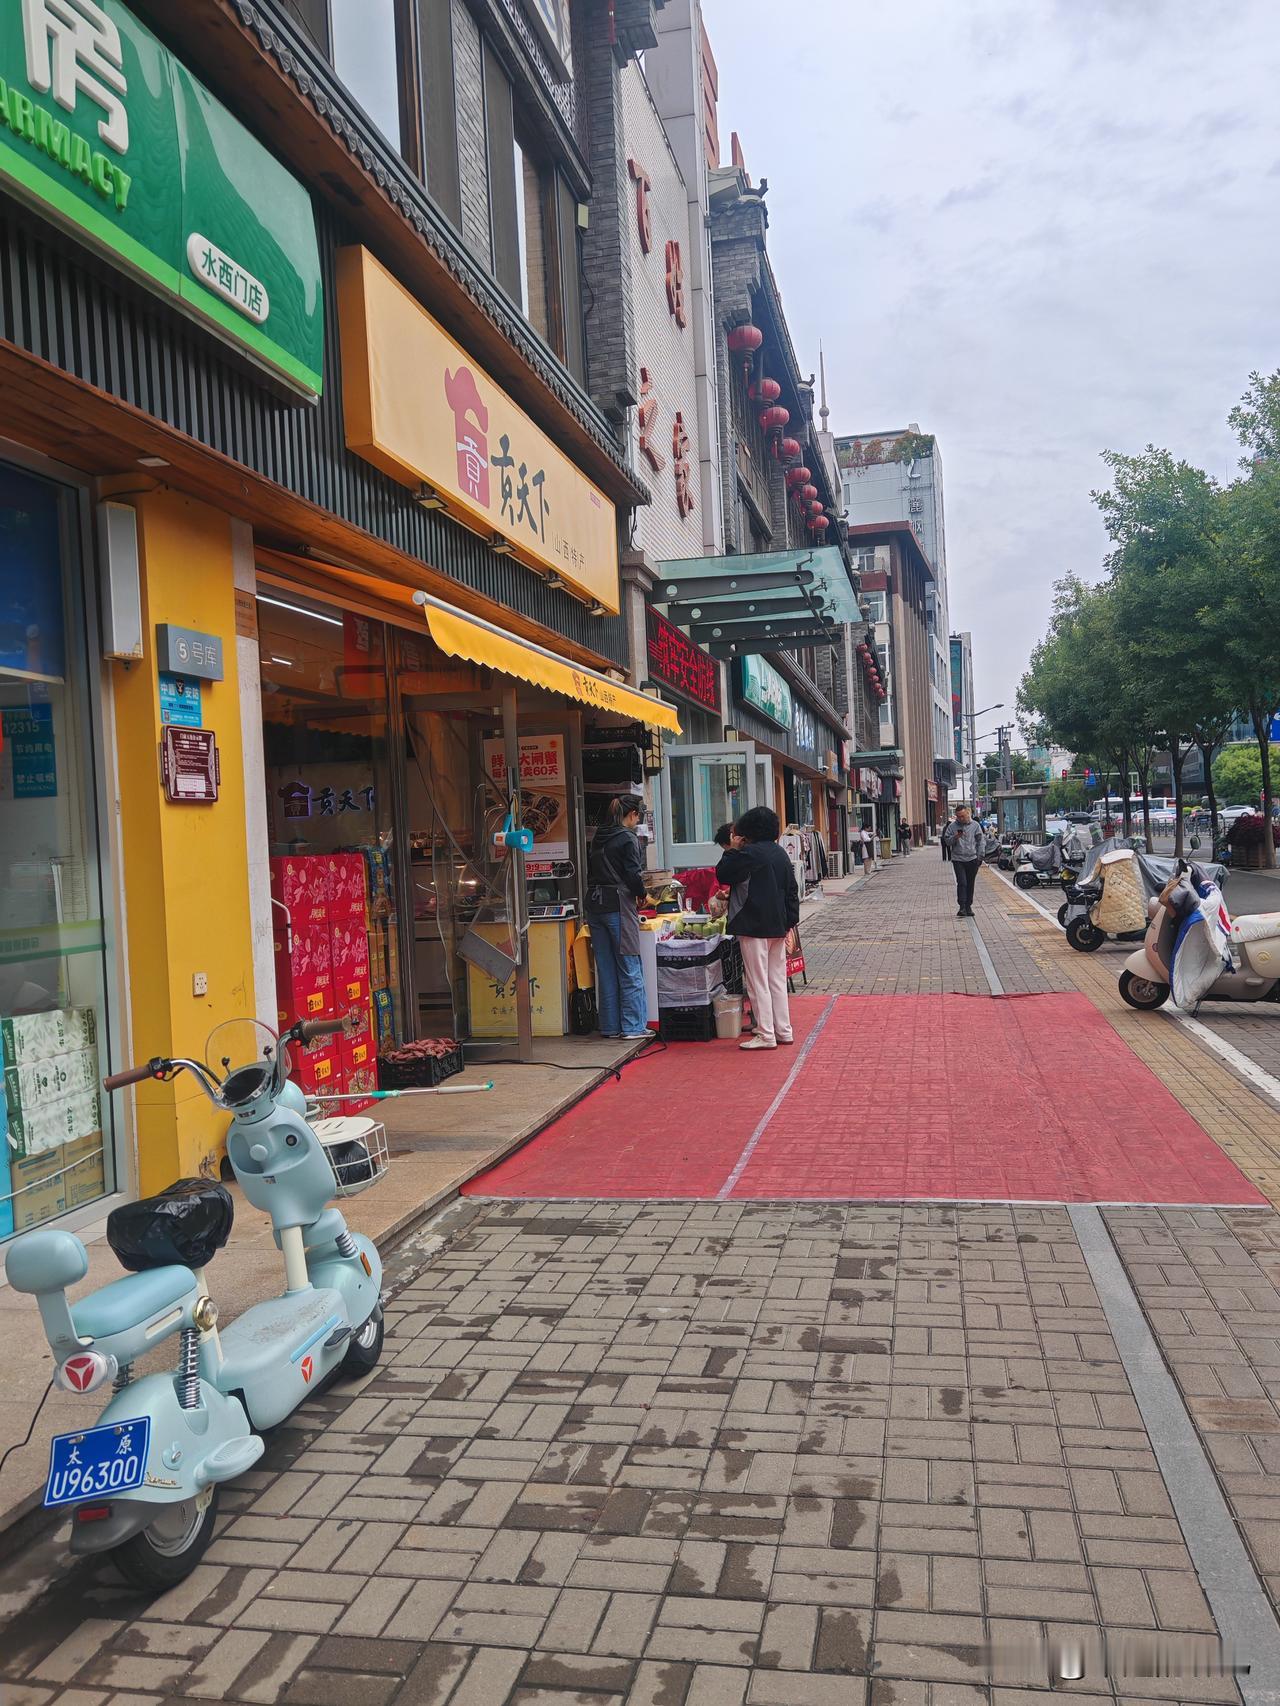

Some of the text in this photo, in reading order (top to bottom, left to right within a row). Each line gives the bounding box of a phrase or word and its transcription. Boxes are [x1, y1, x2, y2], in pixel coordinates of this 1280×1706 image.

[22, 0, 129, 155] 房
[201, 247, 263, 316] 水西门店
[553, 532, 586, 571] 山西特产
[491, 750, 558, 768] 鲜大闸蟹
[491, 765, 559, 778] 每卖60天
[66, 1434, 133, 1466] 太 原
[52, 1455, 139, 1500] U96300
